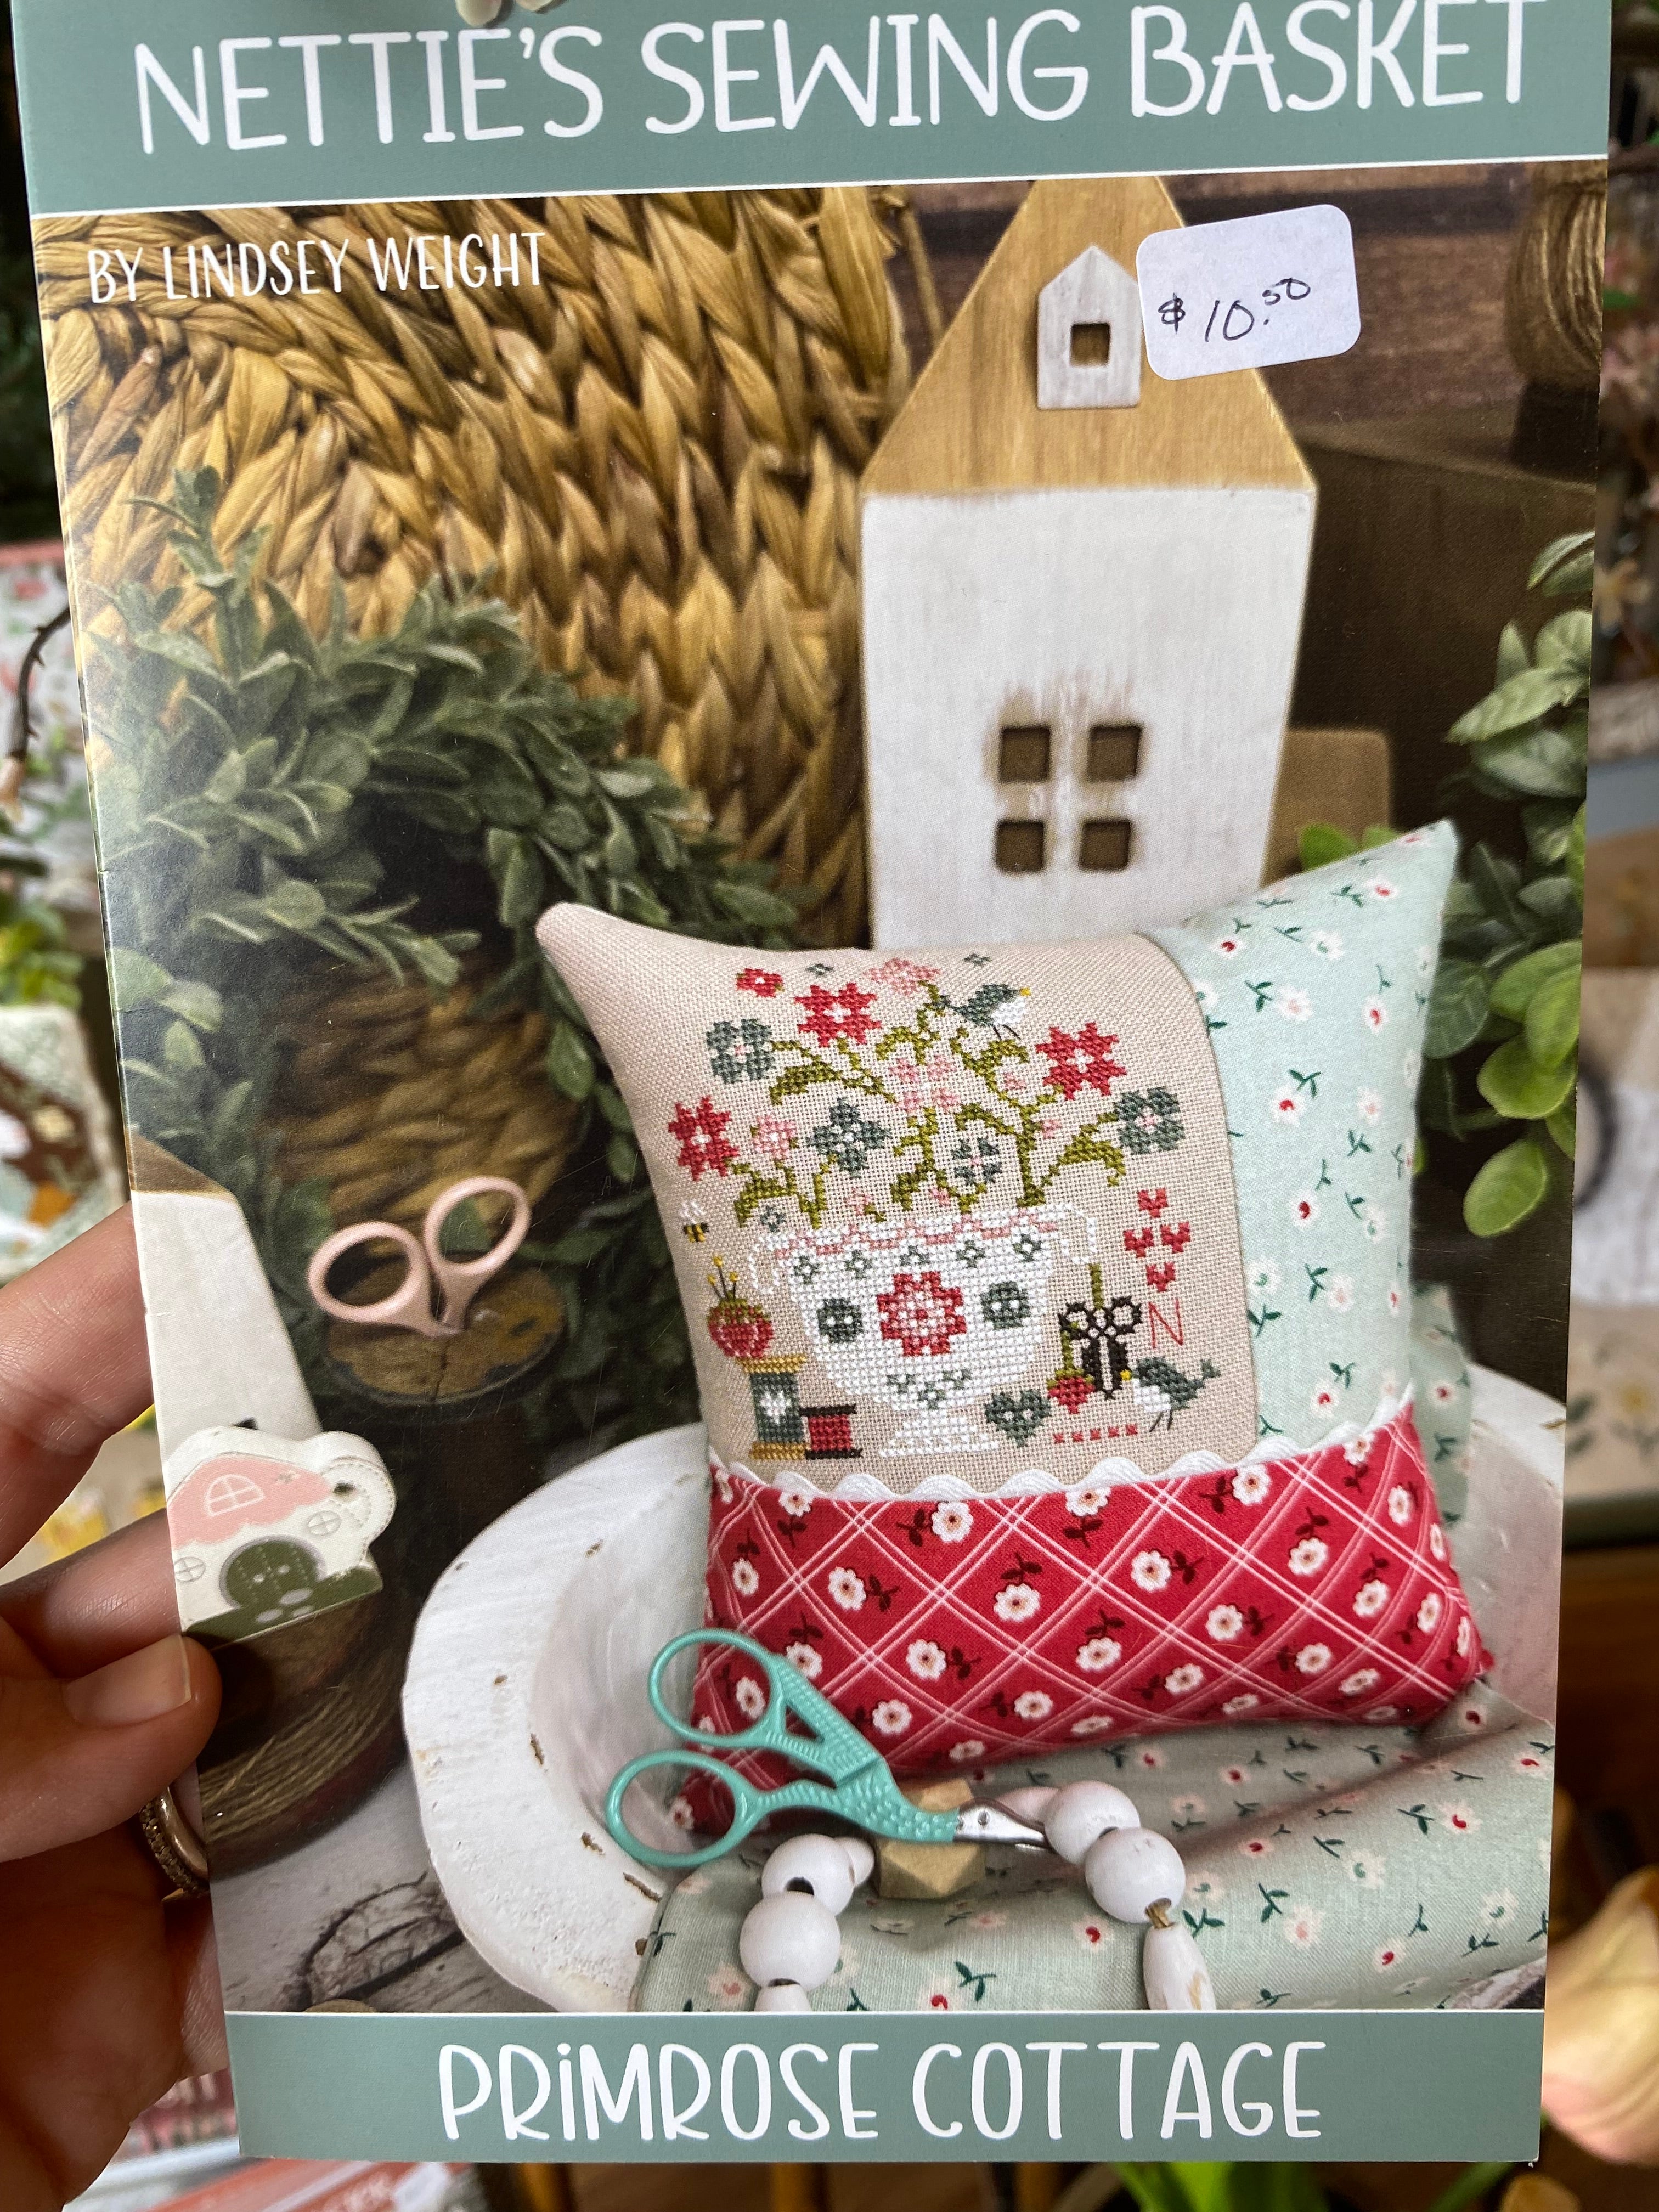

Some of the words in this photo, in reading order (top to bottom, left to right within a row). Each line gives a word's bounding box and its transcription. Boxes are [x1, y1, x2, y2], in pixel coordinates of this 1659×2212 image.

[134, 25, 604, 154] NETTIE'S
[641, 9, 1089, 134] SEWING
[1130, 0, 1547, 117] BASKET
[87, 247, 143, 303] BY
[163, 238, 350, 300] LINDSEY
[367, 232, 545, 292] WEIGHT
[912, 2041, 1327, 2140] COTTAGE
